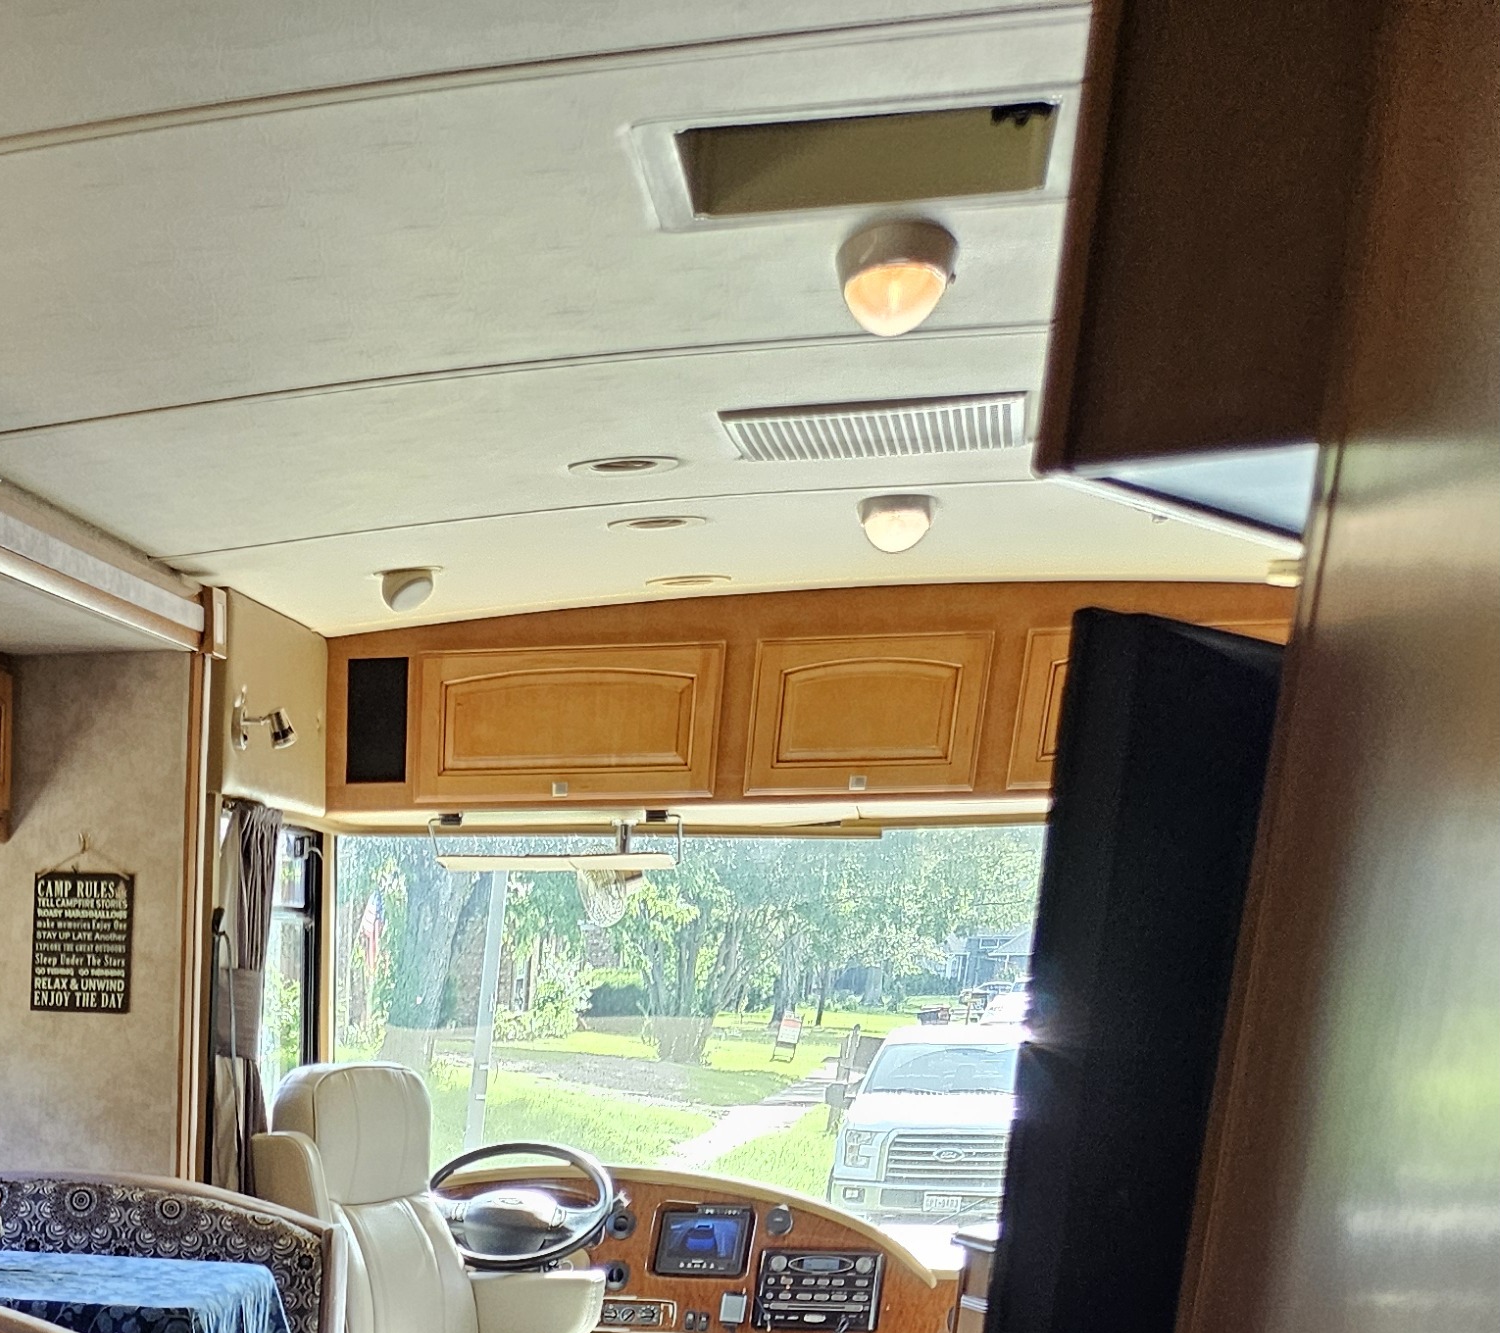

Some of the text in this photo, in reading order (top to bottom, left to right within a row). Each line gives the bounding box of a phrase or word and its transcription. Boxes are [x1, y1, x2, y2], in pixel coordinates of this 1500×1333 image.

[37, 880, 115, 899] CAMP RULES
[37, 897, 128, 910] TELL CAMPFIRE STORIES
[37, 907, 63, 918] ROAST
[36, 930, 57, 940] STAY
[58, 931, 71, 940] UP
[72, 931, 93, 941] LATE
[34, 953, 126, 967] Sleep Under The Stars
[34, 977, 125, 992] RELAX & UNWIND
[33, 990, 124, 1009] ENJOY THE DAY
